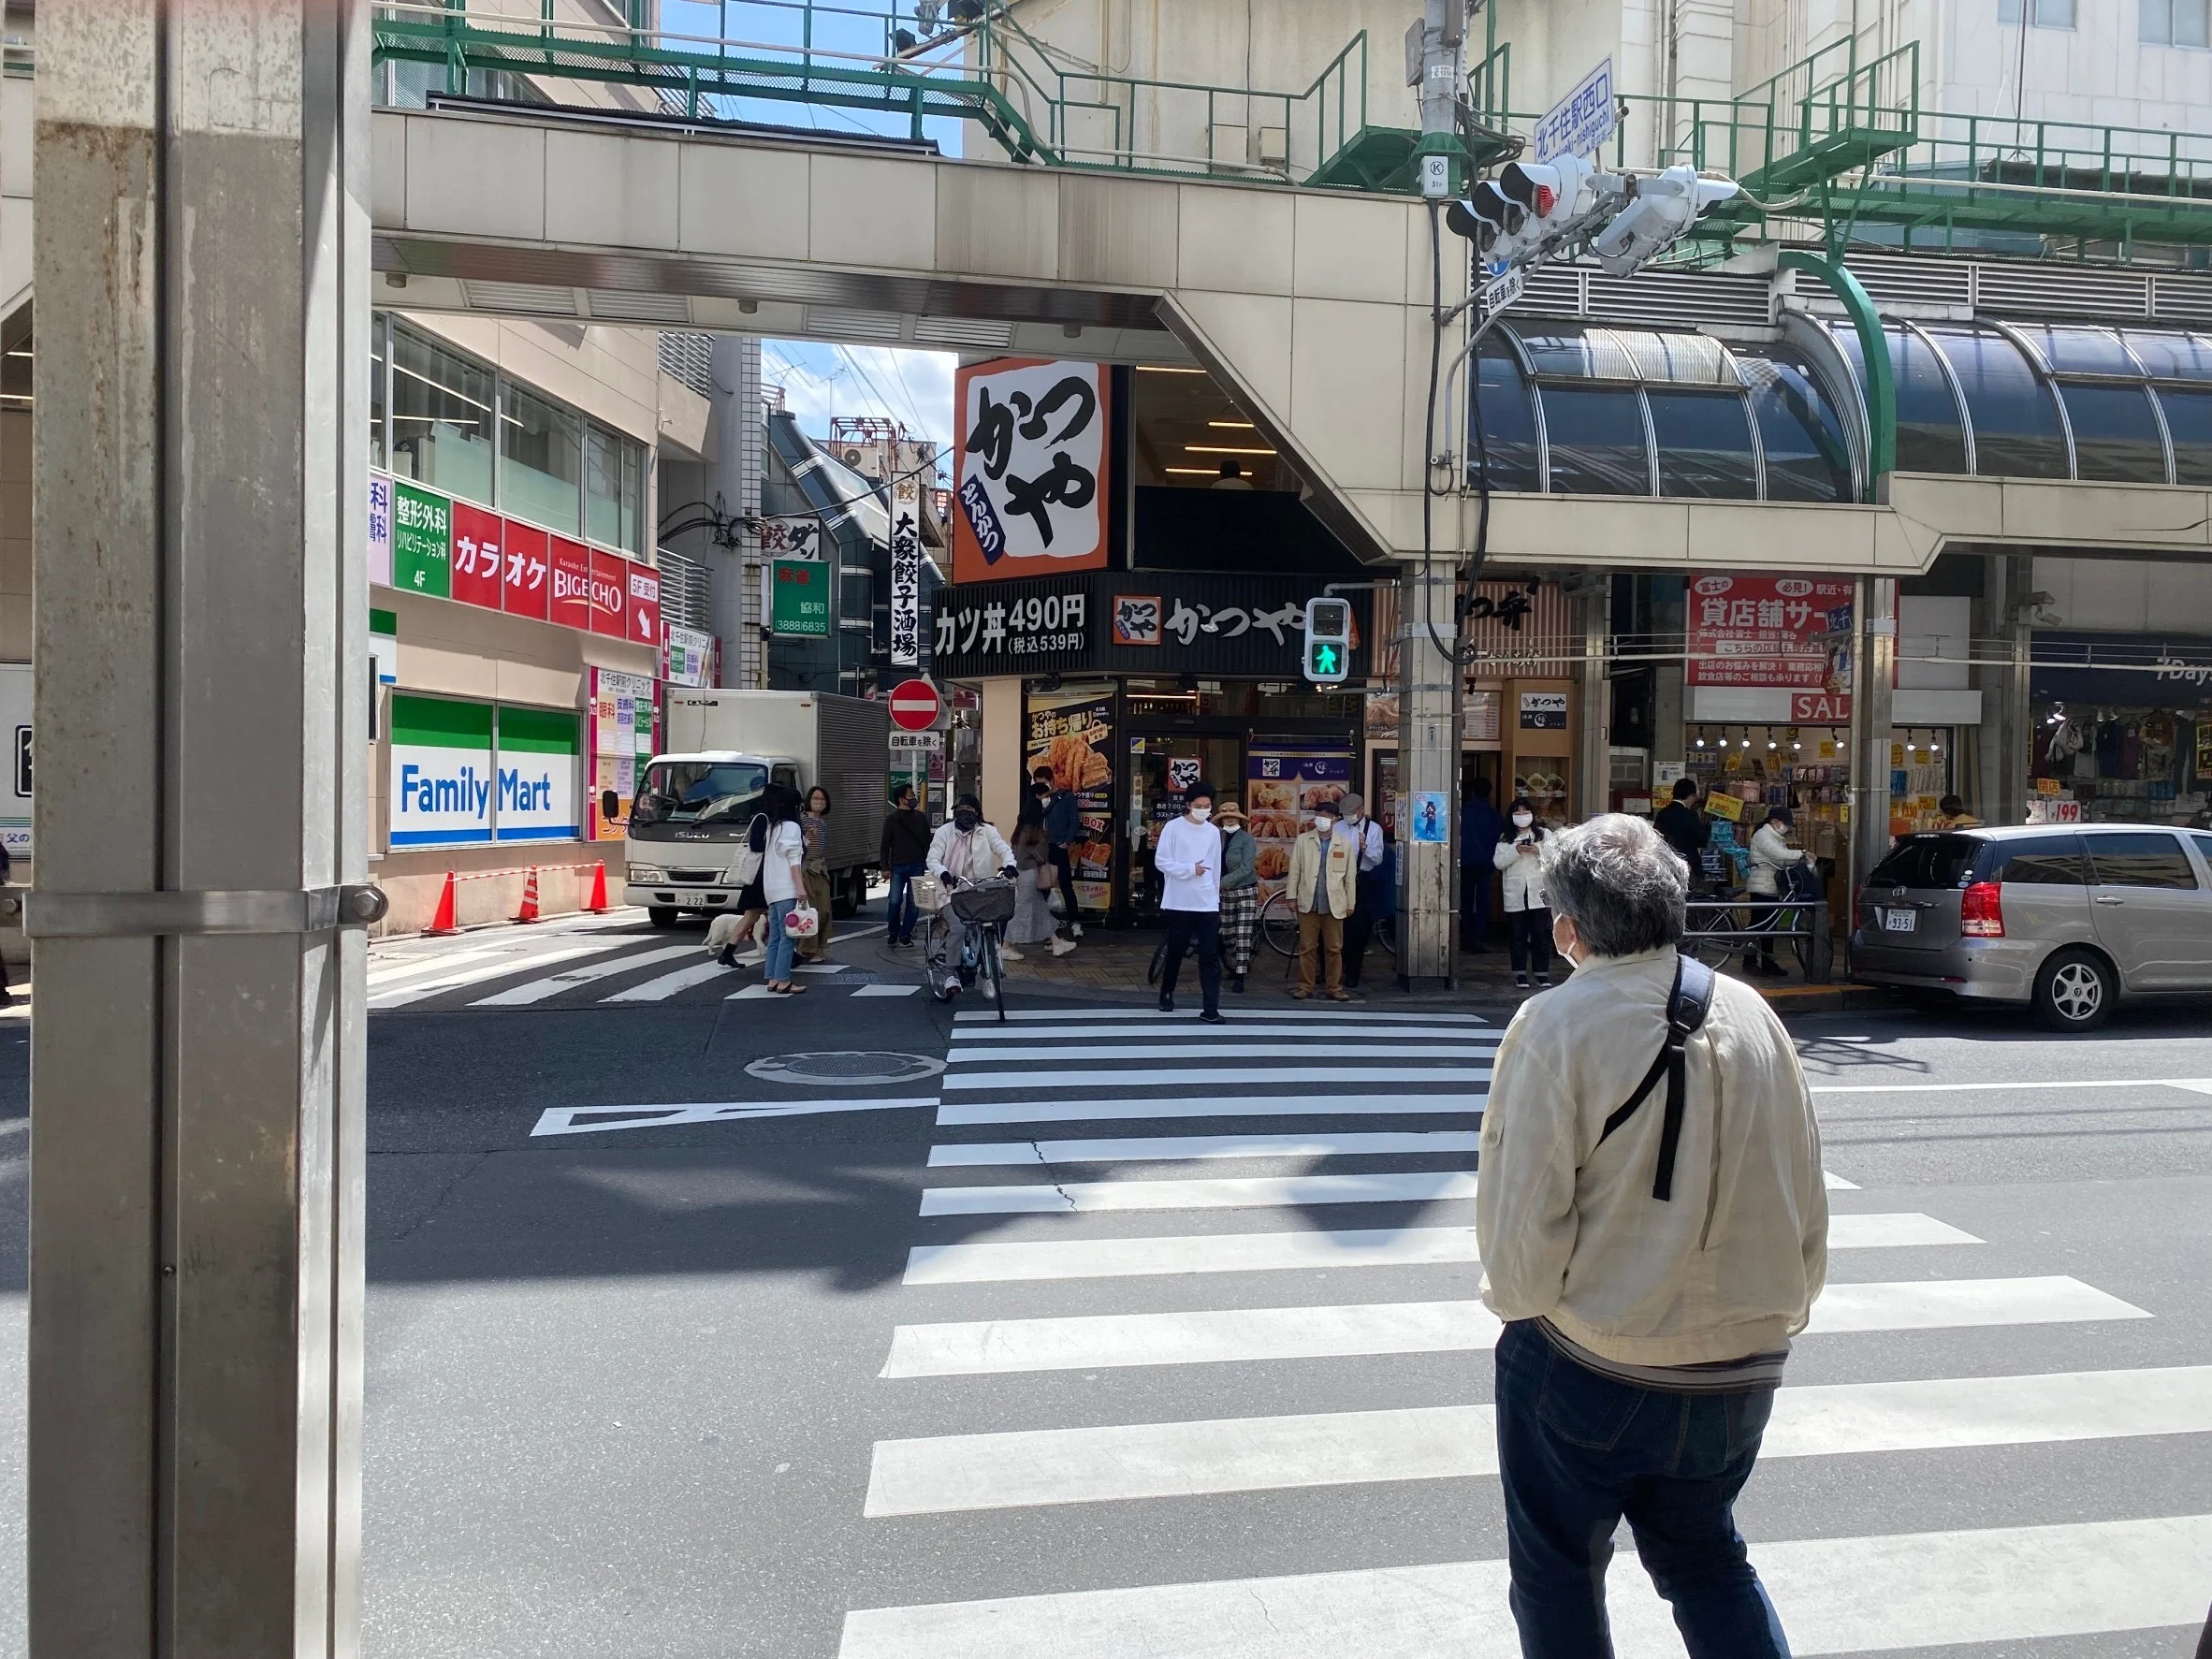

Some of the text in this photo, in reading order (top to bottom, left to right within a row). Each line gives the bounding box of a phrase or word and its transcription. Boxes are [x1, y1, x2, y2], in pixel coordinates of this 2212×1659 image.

[1537, 73, 1608, 159] 北千住駅西口
[1489, 277, 1521, 309] 自転車を除く
[895, 483, 915, 502] 餃
[397, 495, 447, 536] 整形外科
[961, 483, 1000, 552] とんかつ
[397, 529, 446, 561] リハビリテーション科
[455, 535, 546, 590] カラオケ
[560, 558, 579, 572] Karaoke
[414, 569, 427, 588] 4F
[778, 567, 809, 586] 麻雀
[892, 511, 918, 657] 大衆餃子酒場
[1700, 580, 1729, 593] 富士の
[633, 578, 656, 599] 5F 受付
[800, 601, 825, 615] 協和
[935, 593, 1085, 657] カツ丼 490円
[1164, 598, 1306, 647] かつや
[1008, 632, 1084, 655] (税込539円)
[1699, 630, 1753, 640] 株式会社富士
[600, 672, 650, 691] 北千住駅前クリニック
[599, 701, 615, 720] 眼科
[1531, 696, 1565, 708] かつや
[1031, 710, 1093, 739] お持ち帰り
[892, 735, 938, 747] 自転車を除く
[401, 764, 489, 820] Family
[498, 768, 551, 812] Mart
[1892, 918, 1913, 930] 93-51
